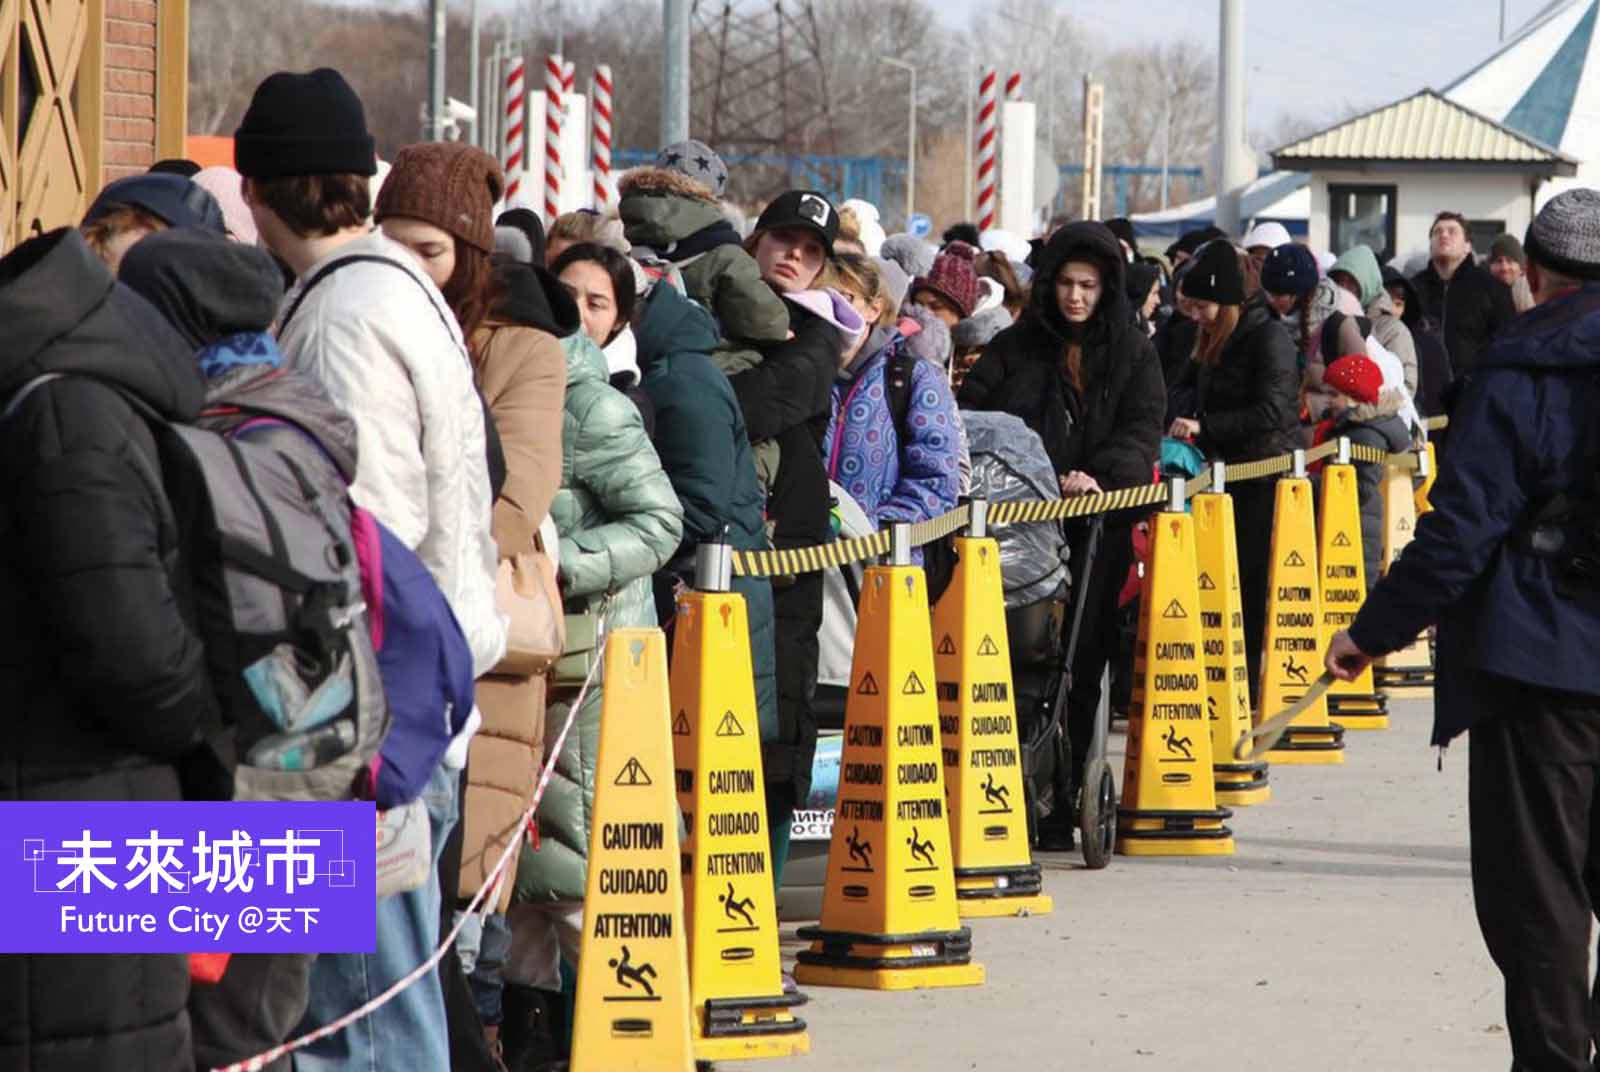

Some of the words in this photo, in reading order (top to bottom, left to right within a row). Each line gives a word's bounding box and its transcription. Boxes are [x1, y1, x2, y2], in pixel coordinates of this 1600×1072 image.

[1326, 565, 1357, 578] CAUTION
[1278, 586, 1311, 601] CAUTION
[1325, 589, 1359, 602] CUIDADO
[1277, 613, 1313, 627] CUIDADO
[1156, 642, 1195, 660] CAUTION
[1274, 637, 1316, 651] ATTENTION
[972, 682, 1008, 702] CAUTION
[1154, 673, 1199, 691] CUIDADO
[1152, 704, 1202, 720] ATTENTION
[847, 724, 883, 747] CAUTION
[897, 724, 934, 746] CAUTION
[972, 716, 1012, 735] CUIDADO
[971, 748, 1016, 768] ATTENTION
[708, 770, 755, 794] CAUTION
[845, 763, 883, 784] CUIDADO
[897, 763, 938, 784] CUIDADO
[840, 799, 883, 821] ATTENTION
[897, 798, 943, 820] ATTENTION
[708, 812, 760, 836] CUIDADO
[603, 822, 664, 851] CAUTION
[707, 852, 765, 876] ATTENTION
[599, 867, 669, 895] CUIDADO
[593, 912, 673, 939] ATTENTION
